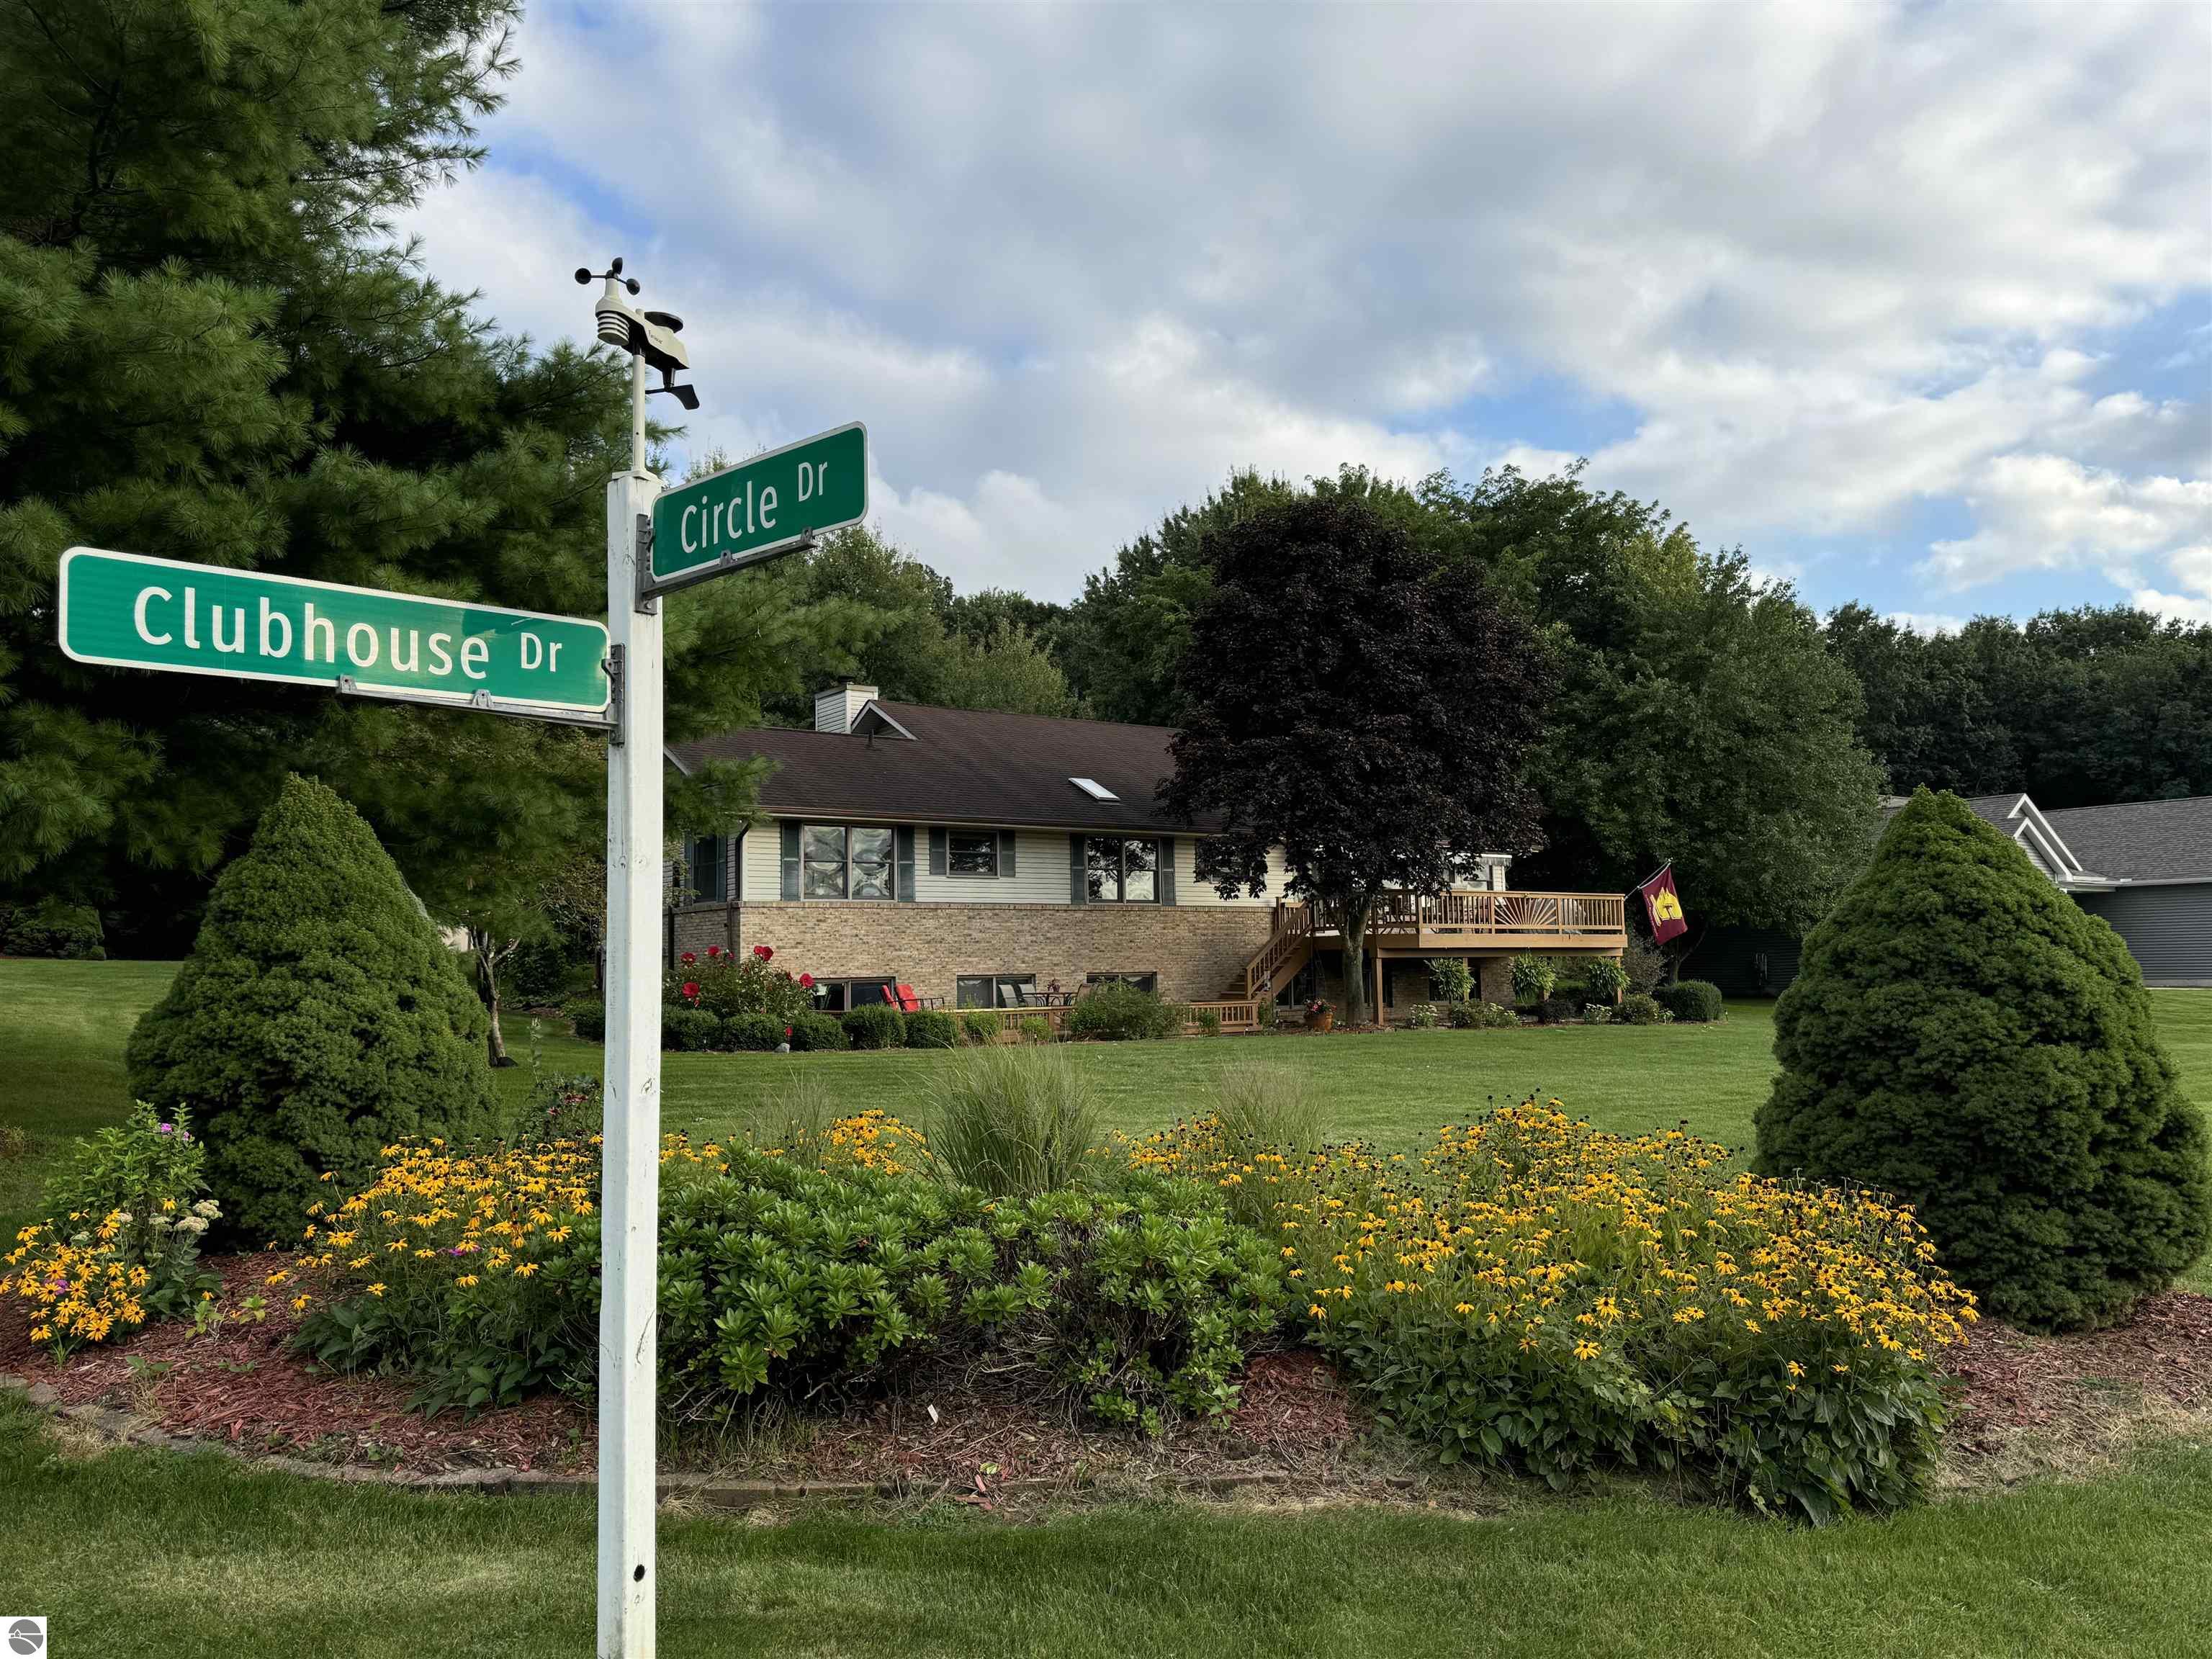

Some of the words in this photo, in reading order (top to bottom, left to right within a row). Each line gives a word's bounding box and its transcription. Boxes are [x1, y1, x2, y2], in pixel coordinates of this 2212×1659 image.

[681, 480, 778, 554] Circle
[798, 462, 828, 502] Dr
[134, 586, 490, 680] Clubhouse
[520, 632, 563, 673] Dr
